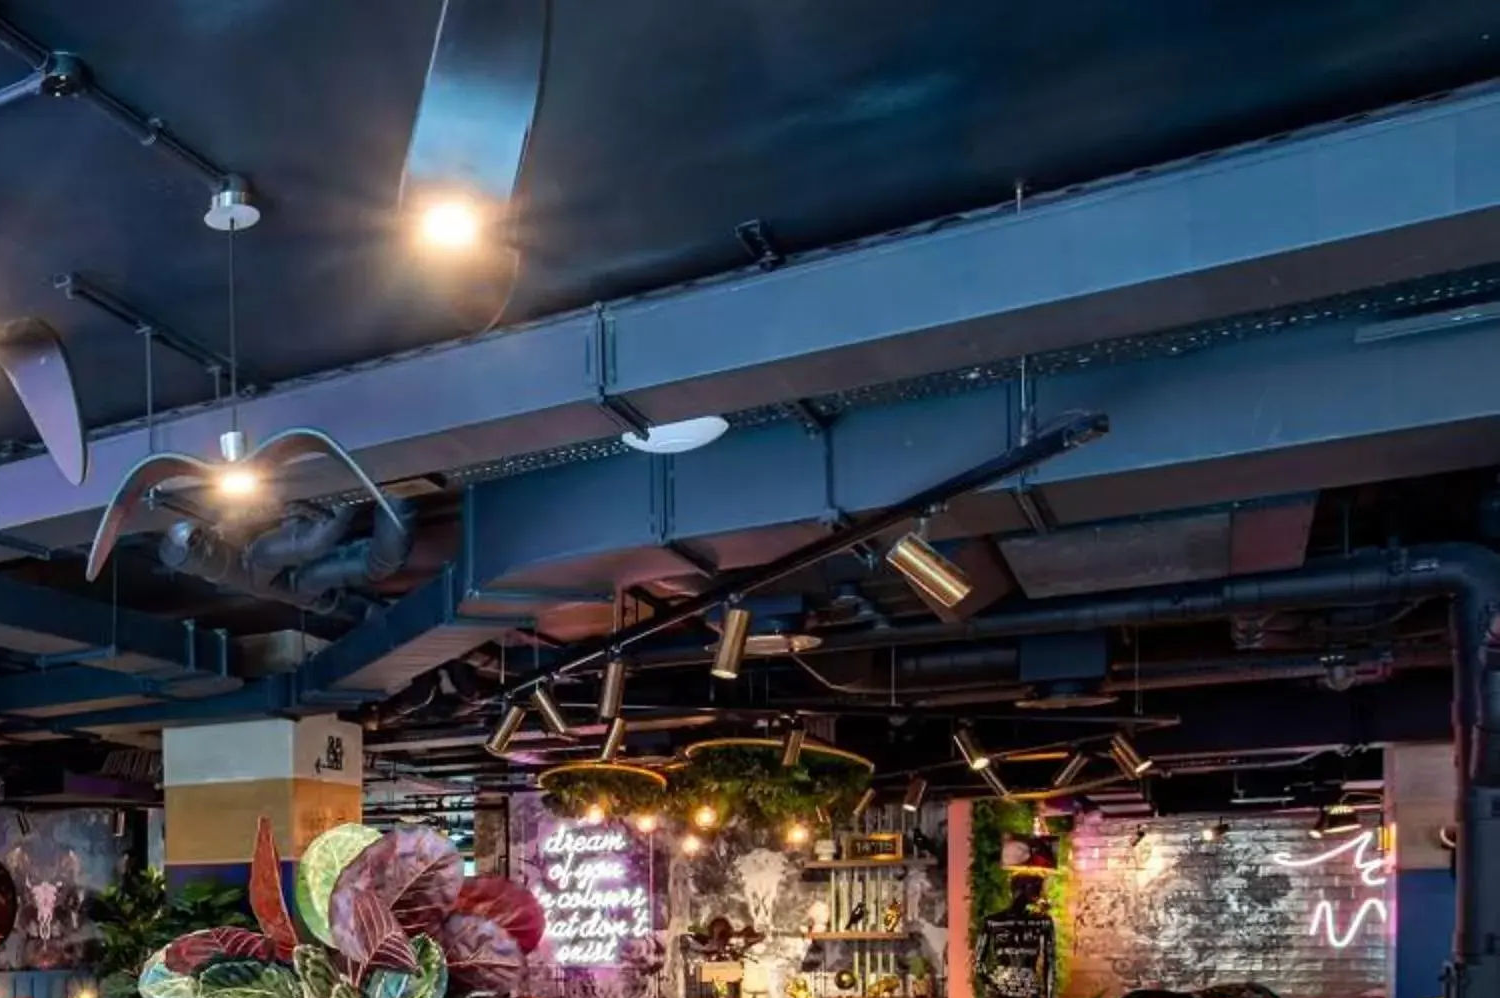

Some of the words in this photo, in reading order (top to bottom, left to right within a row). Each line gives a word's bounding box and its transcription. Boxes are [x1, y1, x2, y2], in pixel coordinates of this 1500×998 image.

[544, 825, 627, 853] dream
[548, 852, 574, 889] of
[574, 861, 625, 889] you
[557, 879, 647, 907] colours
